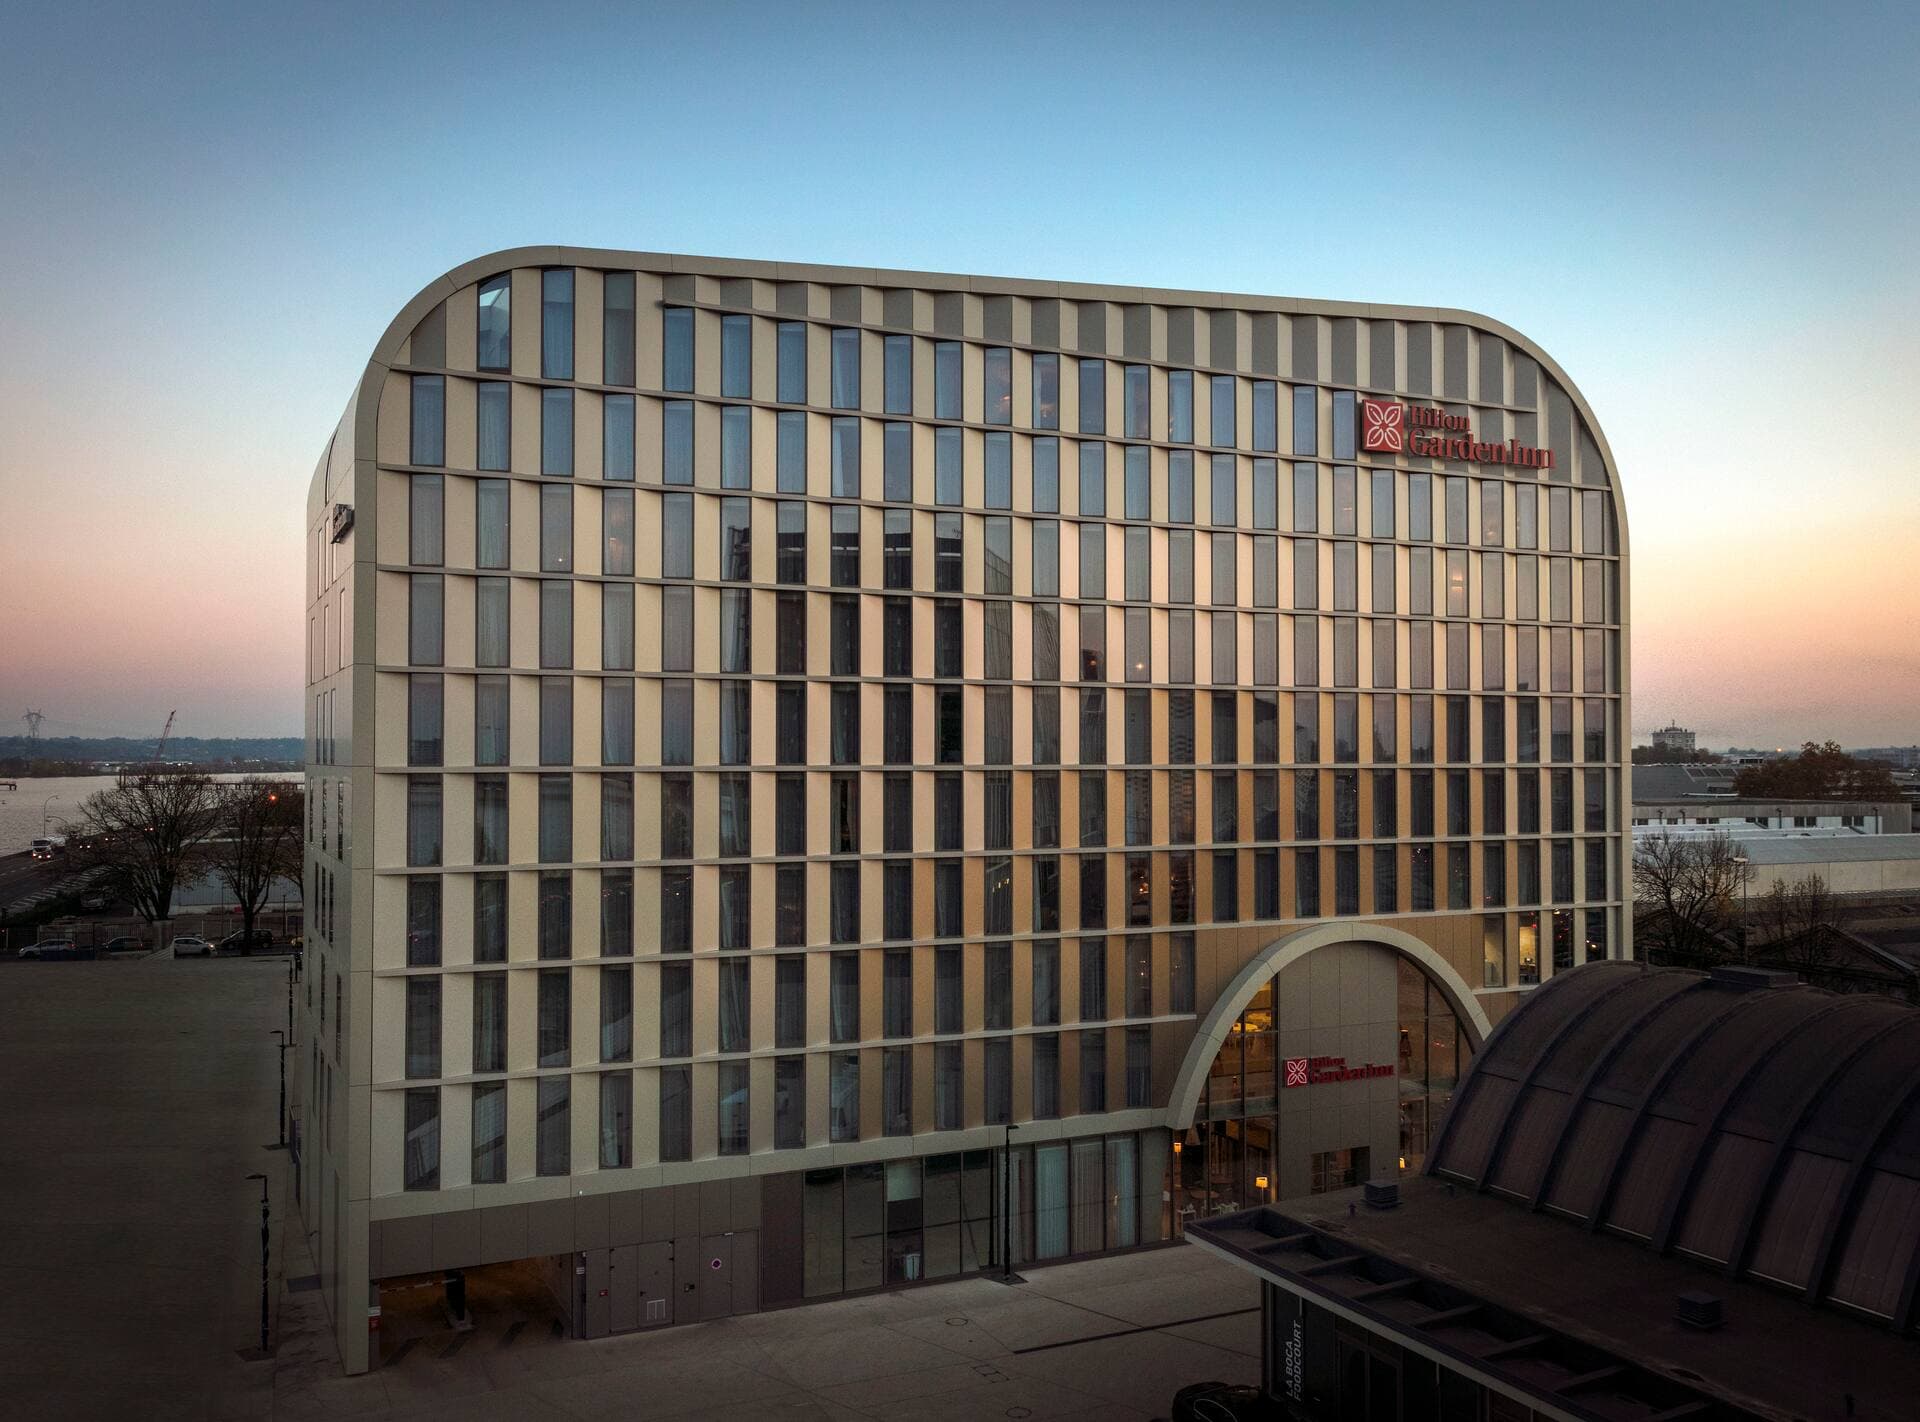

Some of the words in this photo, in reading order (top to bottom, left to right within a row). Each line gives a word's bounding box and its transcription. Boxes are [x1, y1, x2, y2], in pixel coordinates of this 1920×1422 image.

[1409, 404, 1470, 430] Hilton
[1409, 429, 1506, 463] Garden
[1510, 439, 1555, 468] Inn
[1285, 1341, 1294, 1376] BOCA
[1293, 1320, 1302, 1402] FOODCOURT
[1285, 1380, 1294, 1397] LA
